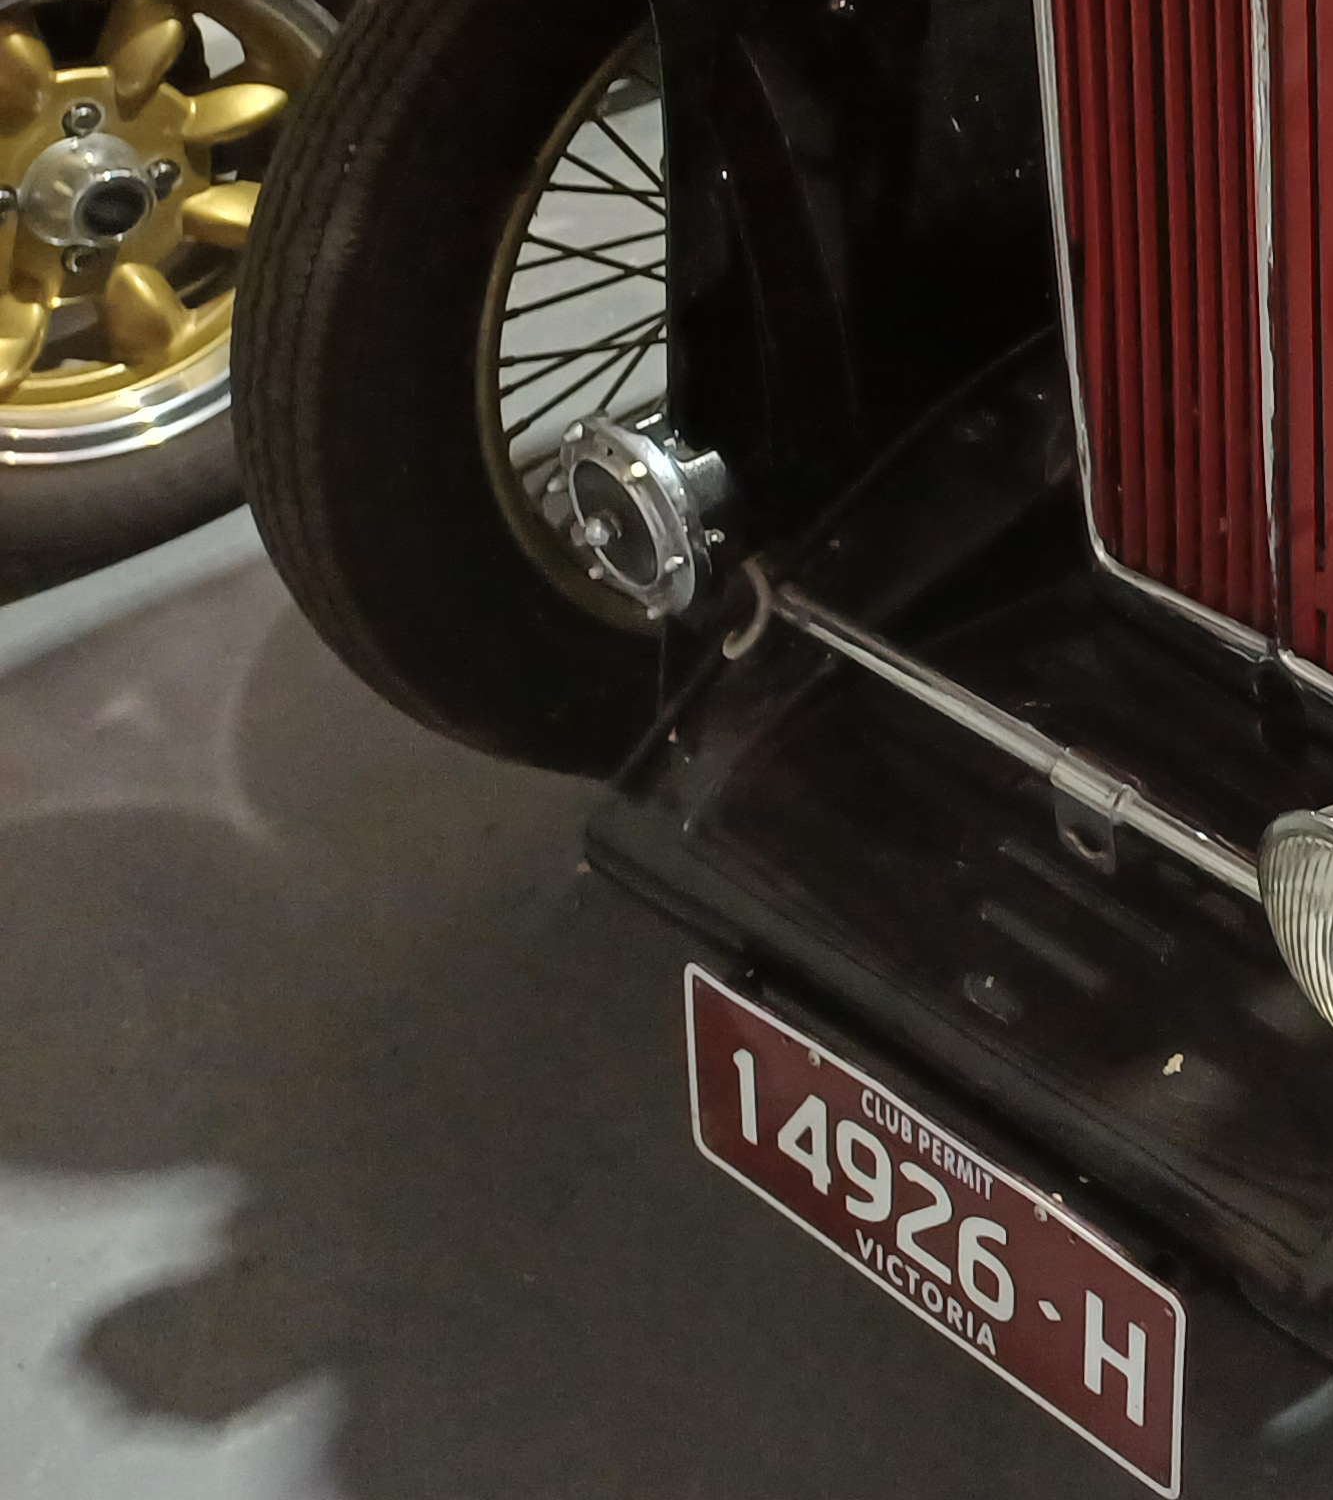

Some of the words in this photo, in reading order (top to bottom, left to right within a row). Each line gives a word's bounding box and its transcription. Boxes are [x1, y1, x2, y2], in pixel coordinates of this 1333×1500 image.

[861, 1088, 914, 1146] CLUB
[918, 1124, 995, 1200] PERMIT
[854, 1228, 997, 1357] VICTORIA
